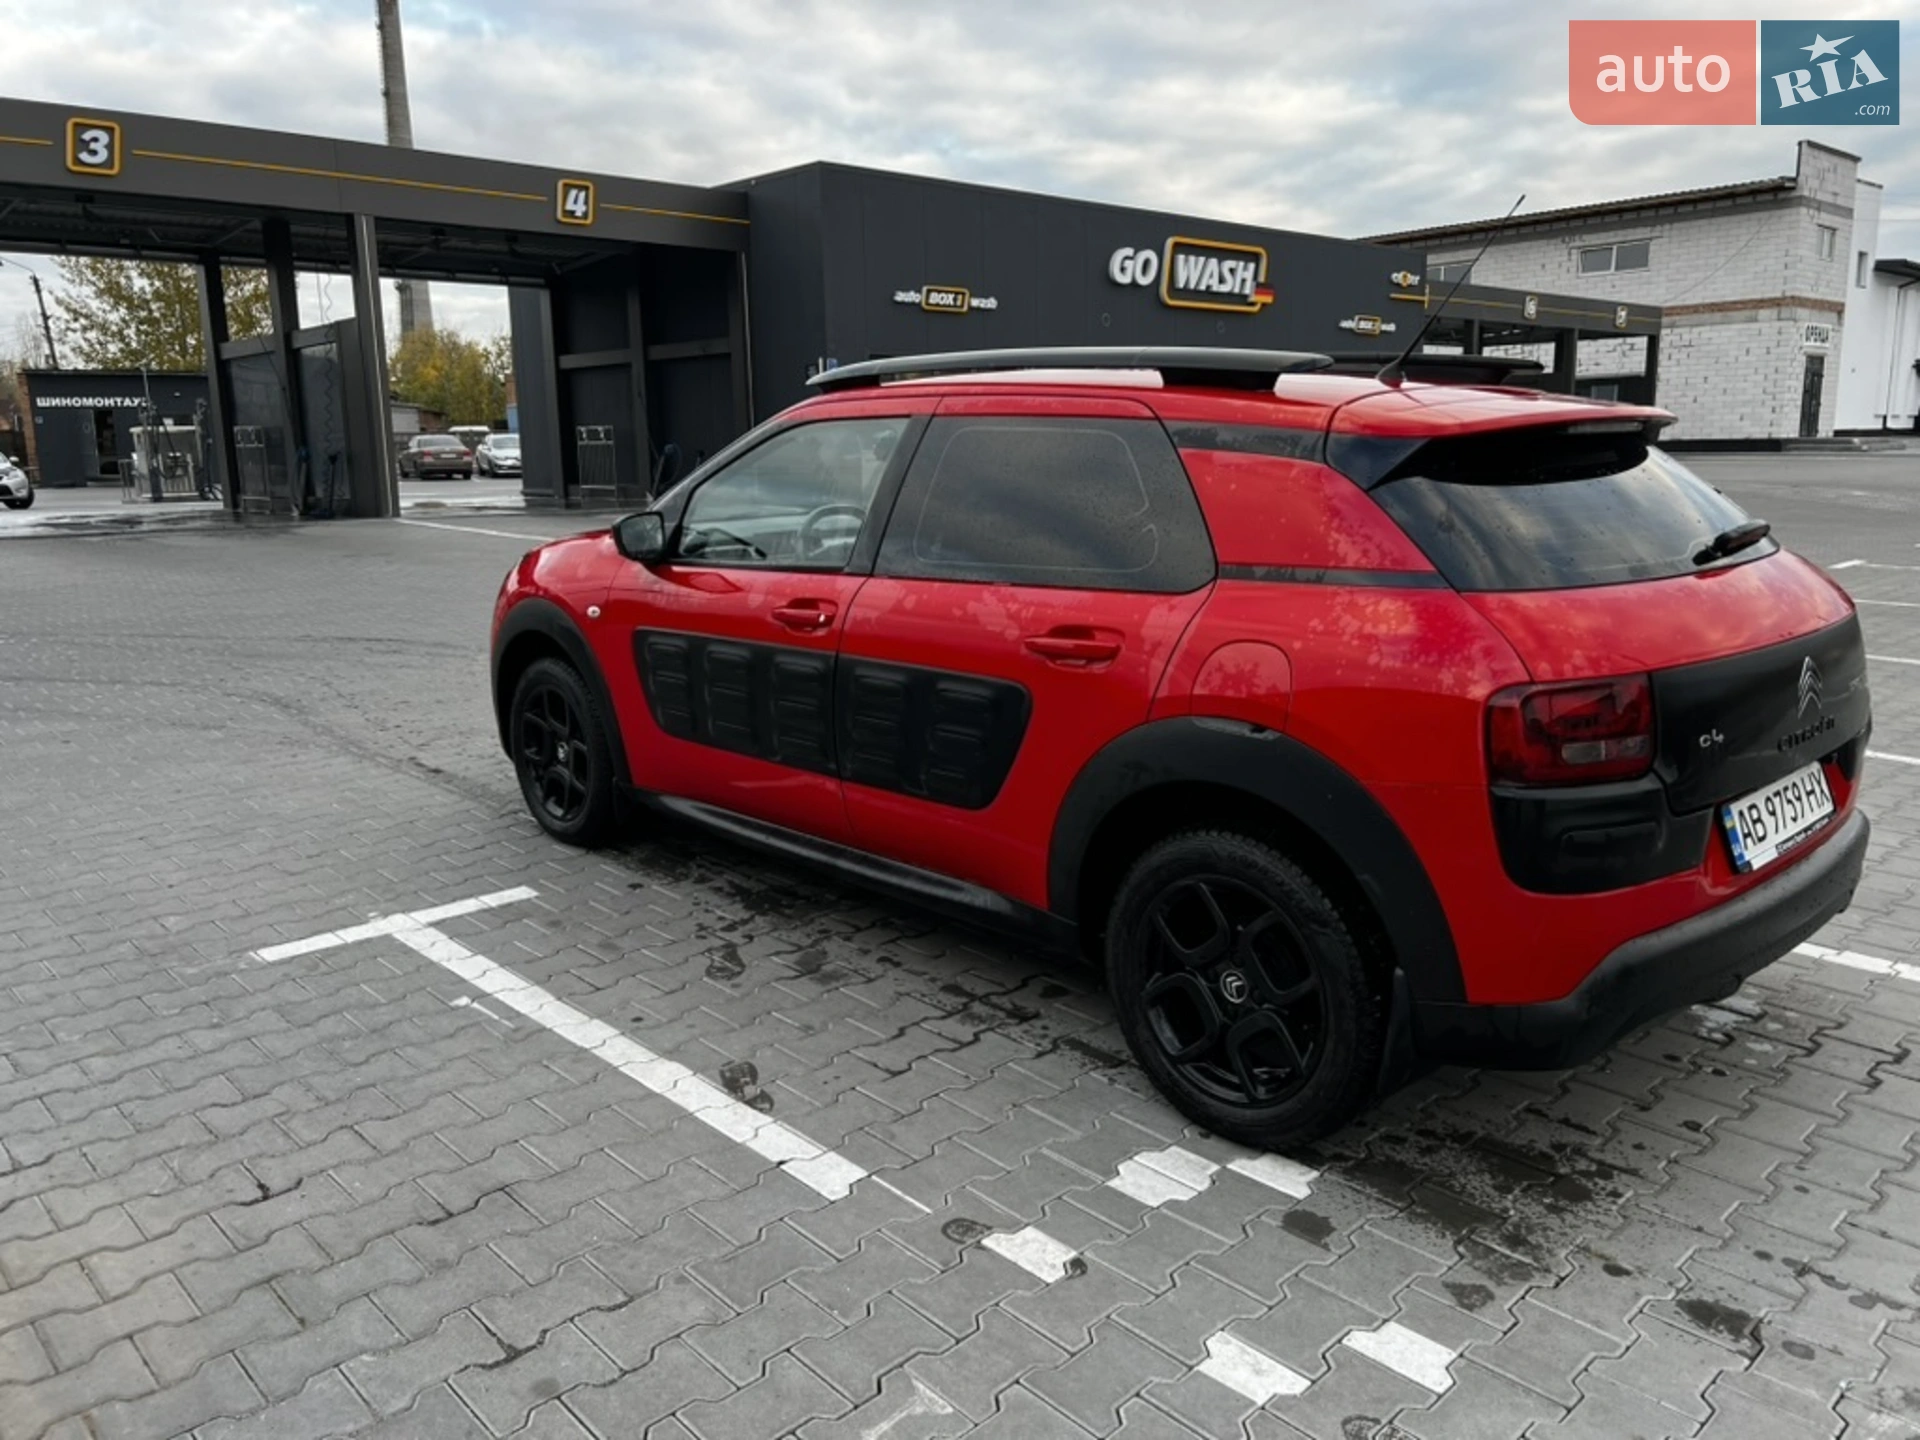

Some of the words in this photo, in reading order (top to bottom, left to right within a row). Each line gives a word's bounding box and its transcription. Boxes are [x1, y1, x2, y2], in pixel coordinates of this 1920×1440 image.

[78, 129, 110, 165] 3
[565, 188, 587, 217] 4
[1109, 247, 1158, 286] GO
[1174, 254, 1256, 296] WASH
[928, 292, 955, 306] BOX
[1738, 802, 1767, 851] AB
[1764, 781, 1804, 834] 9759
[1801, 768, 1830, 812] HX
